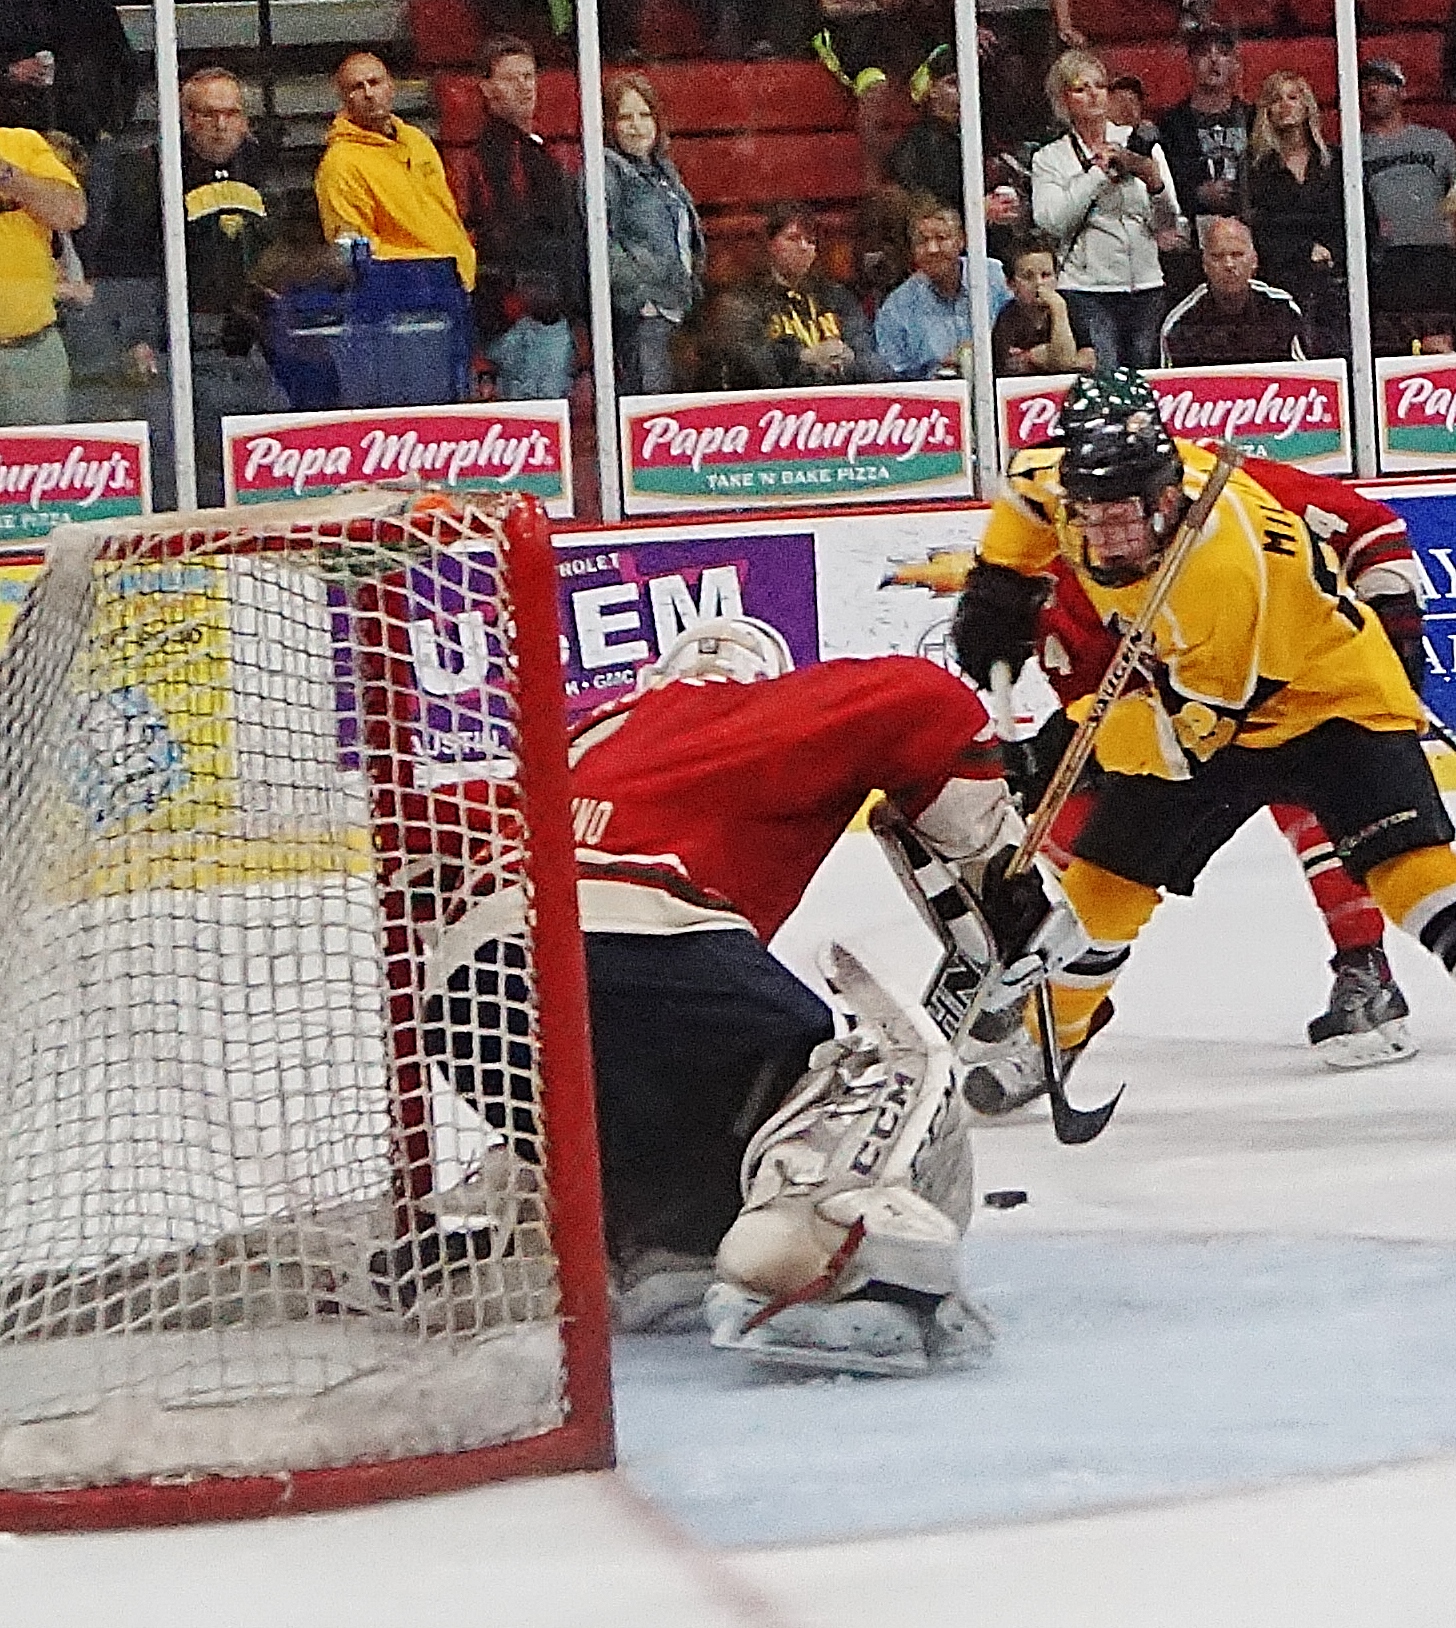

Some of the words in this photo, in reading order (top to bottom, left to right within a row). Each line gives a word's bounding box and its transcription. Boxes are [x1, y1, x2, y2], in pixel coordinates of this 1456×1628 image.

[244, 437, 352, 495] Papa
[360, 423, 552, 486] Murphy's
[642, 417, 748, 473] Papa
[758, 402, 951, 465] Murphy's
[0, 446, 130, 511] urphy's
[706, 472, 753, 489] TAKE
[781, 469, 832, 485] BAKE
[838, 466, 890, 481] PIZZA
[593, 670, 635, 689] GMC
